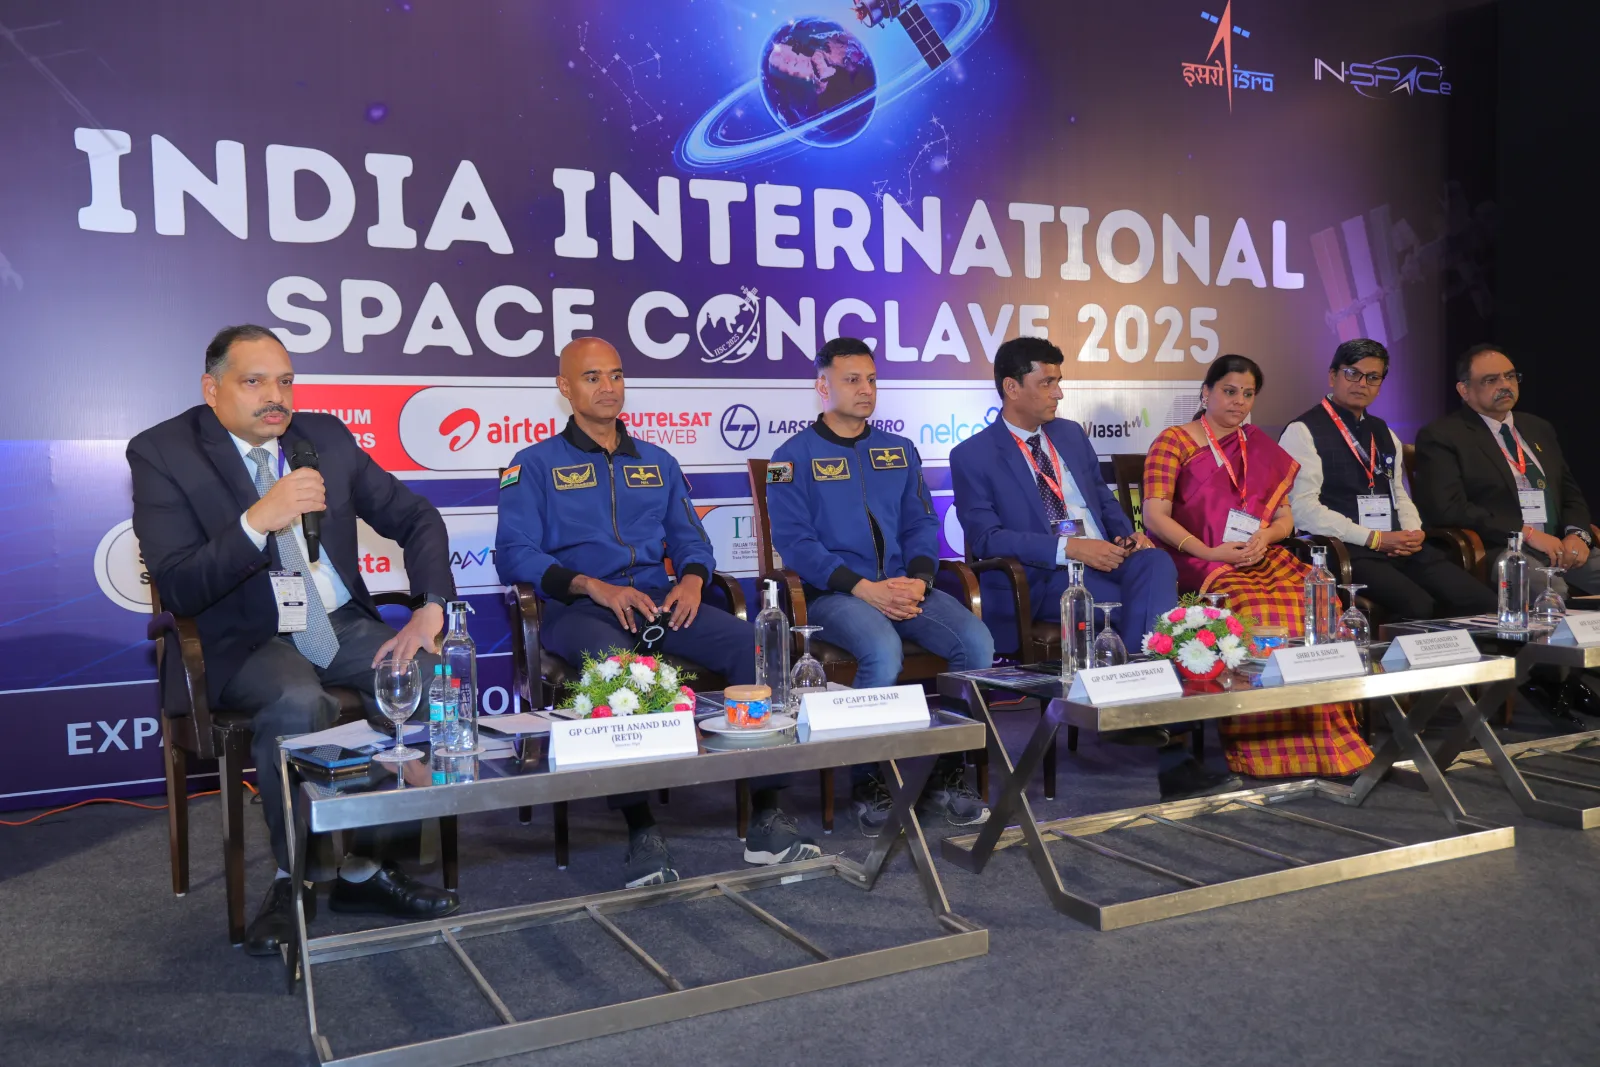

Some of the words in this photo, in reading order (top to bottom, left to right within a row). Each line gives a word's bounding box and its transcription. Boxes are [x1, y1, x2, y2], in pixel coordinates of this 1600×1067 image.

[74, 127, 515, 255] INDIA
[552, 167, 1305, 290] INTERNATIONAL
[266, 275, 595, 358] SPACE
[1076, 304, 1219, 364] 2025
[487, 415, 556, 444] airtel
[626, 429, 697, 445] NEWEB
[1083, 420, 1132, 438] Viasat
[1295, 651, 1310, 660] SHRI
[1320, 648, 1339, 657] SINGH
[1101, 673, 1118, 682] CAPT
[1119, 671, 1141, 680] ANGAD
[1141, 667, 1164, 676] PRATAP
[832, 697, 844, 705] GP
[845, 695, 867, 704] CAPT
[867, 694, 879, 702] PB
[880, 692, 899, 701] NAIR
[67, 717, 163, 755] EXP
[569, 728, 582, 737] GP
[584, 725, 609, 735] CAPT
[610, 724, 625, 733] TH
[627, 721, 660, 731] ANAND
[661, 718, 681, 728] RAO
[611, 732, 643, 744] (RETD)
